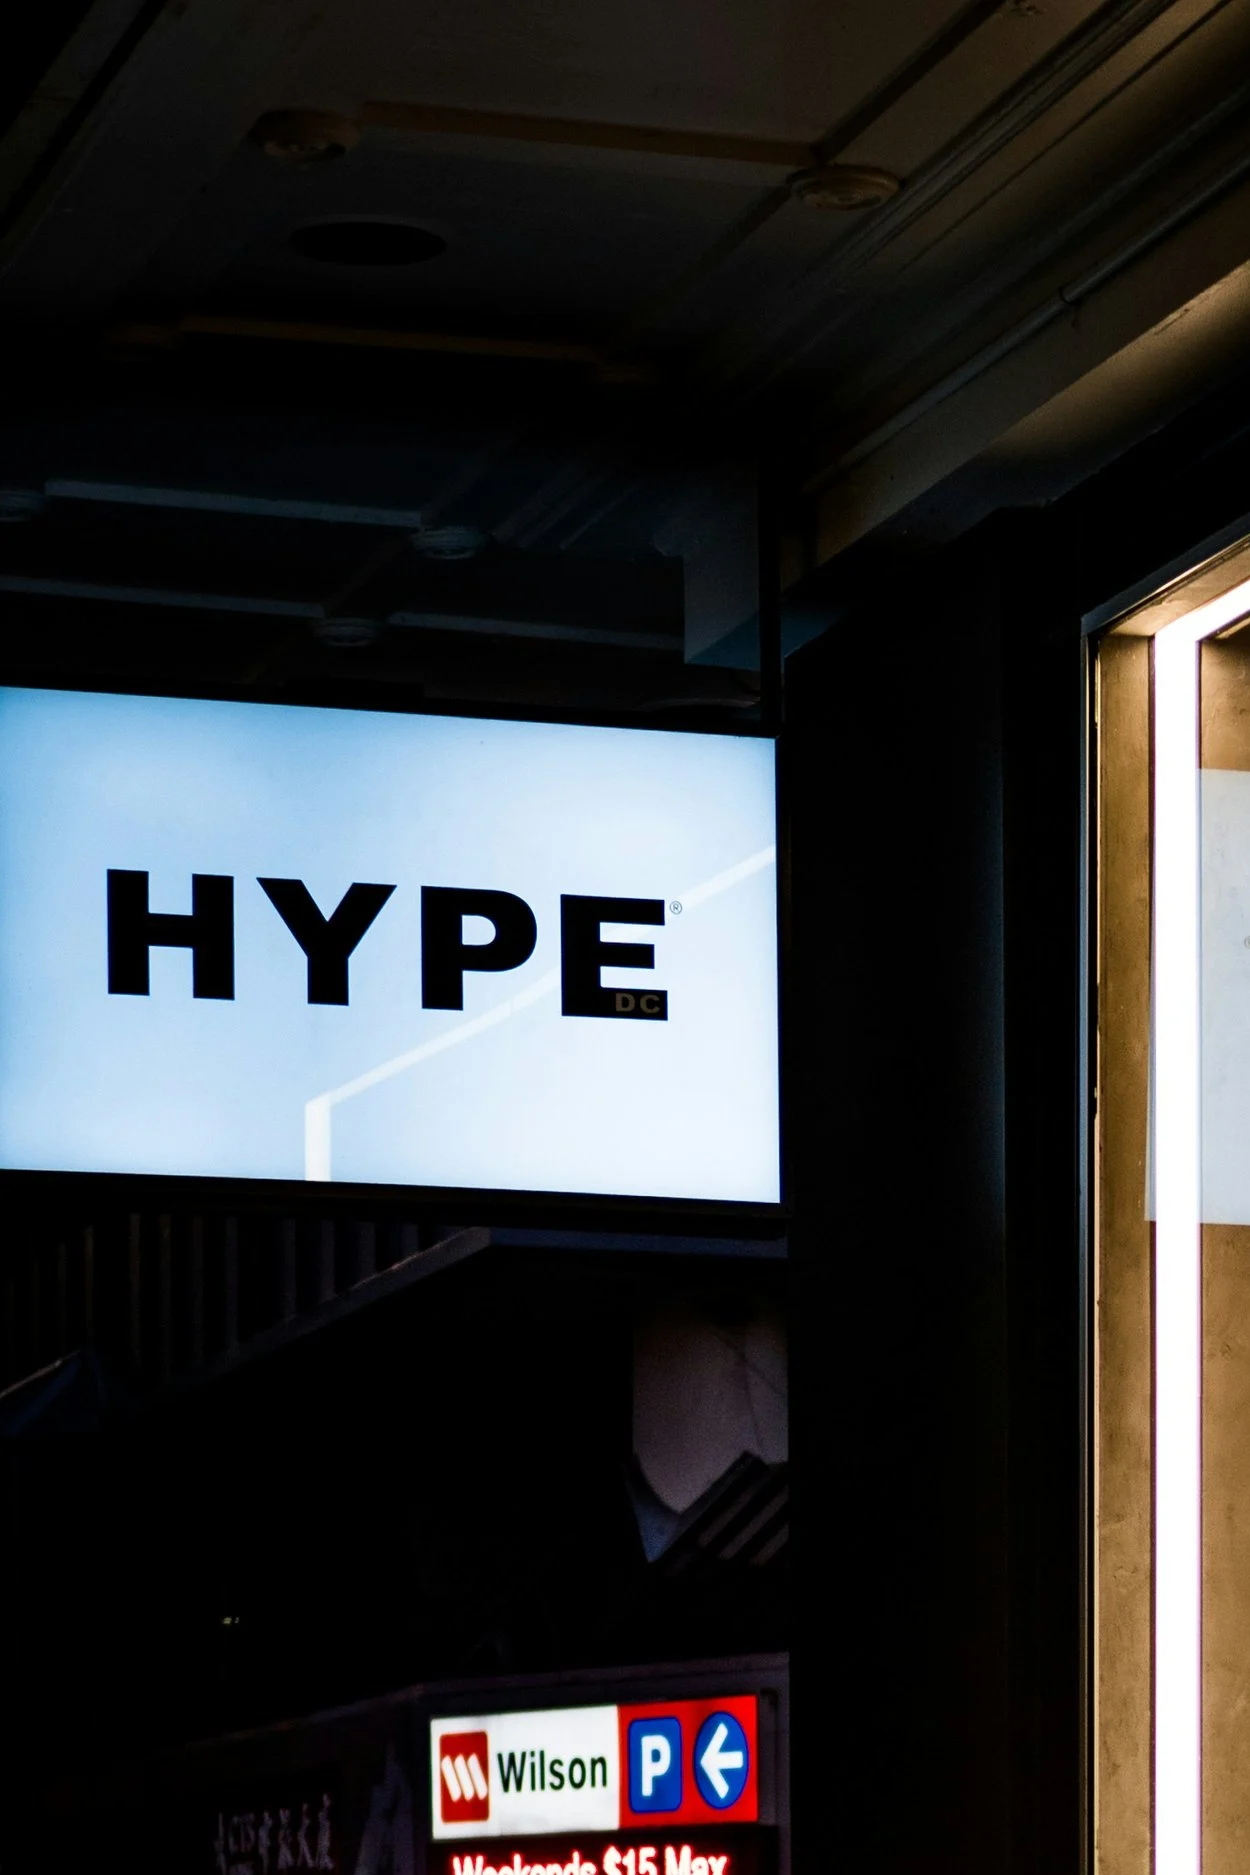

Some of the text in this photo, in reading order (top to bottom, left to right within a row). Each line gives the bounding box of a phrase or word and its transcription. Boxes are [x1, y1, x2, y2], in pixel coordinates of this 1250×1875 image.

[107, 868, 669, 1021] HYPE
[615, 992, 661, 1014] DC
[497, 1750, 608, 1793] Wilson
[641, 1734, 672, 1797] P
